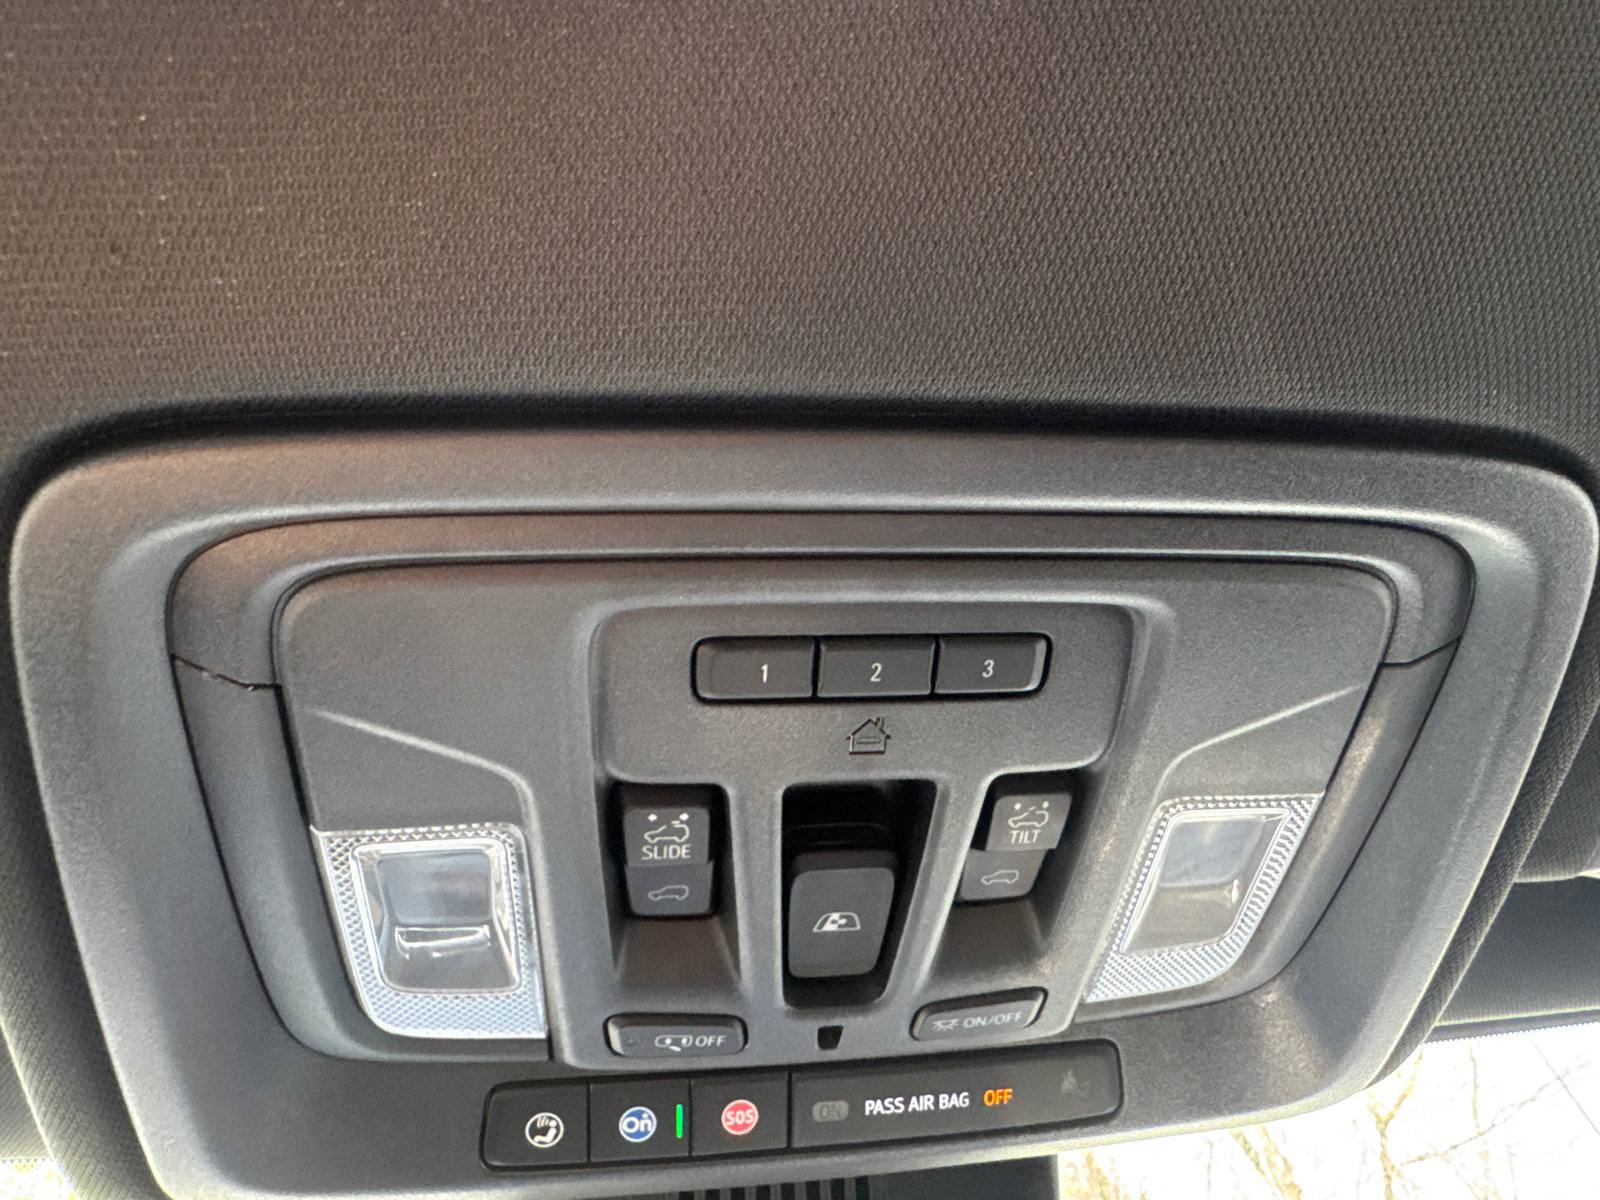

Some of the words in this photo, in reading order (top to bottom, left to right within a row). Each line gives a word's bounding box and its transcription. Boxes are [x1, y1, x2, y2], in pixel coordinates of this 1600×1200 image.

[760, 664, 769, 682] 1
[870, 663, 882, 682] 2
[981, 660, 995, 678] 3
[1009, 828, 1041, 845] TILT
[641, 843, 691, 860] SLIDE
[963, 1010, 1023, 1028] ON/OFF
[695, 1034, 727, 1048] OFF
[864, 1097, 905, 1116] PASS
[907, 1095, 935, 1113] AIR
[938, 1091, 970, 1111] BAG
[983, 1088, 1013, 1106] OFF
[725, 1109, 755, 1126] SOS
